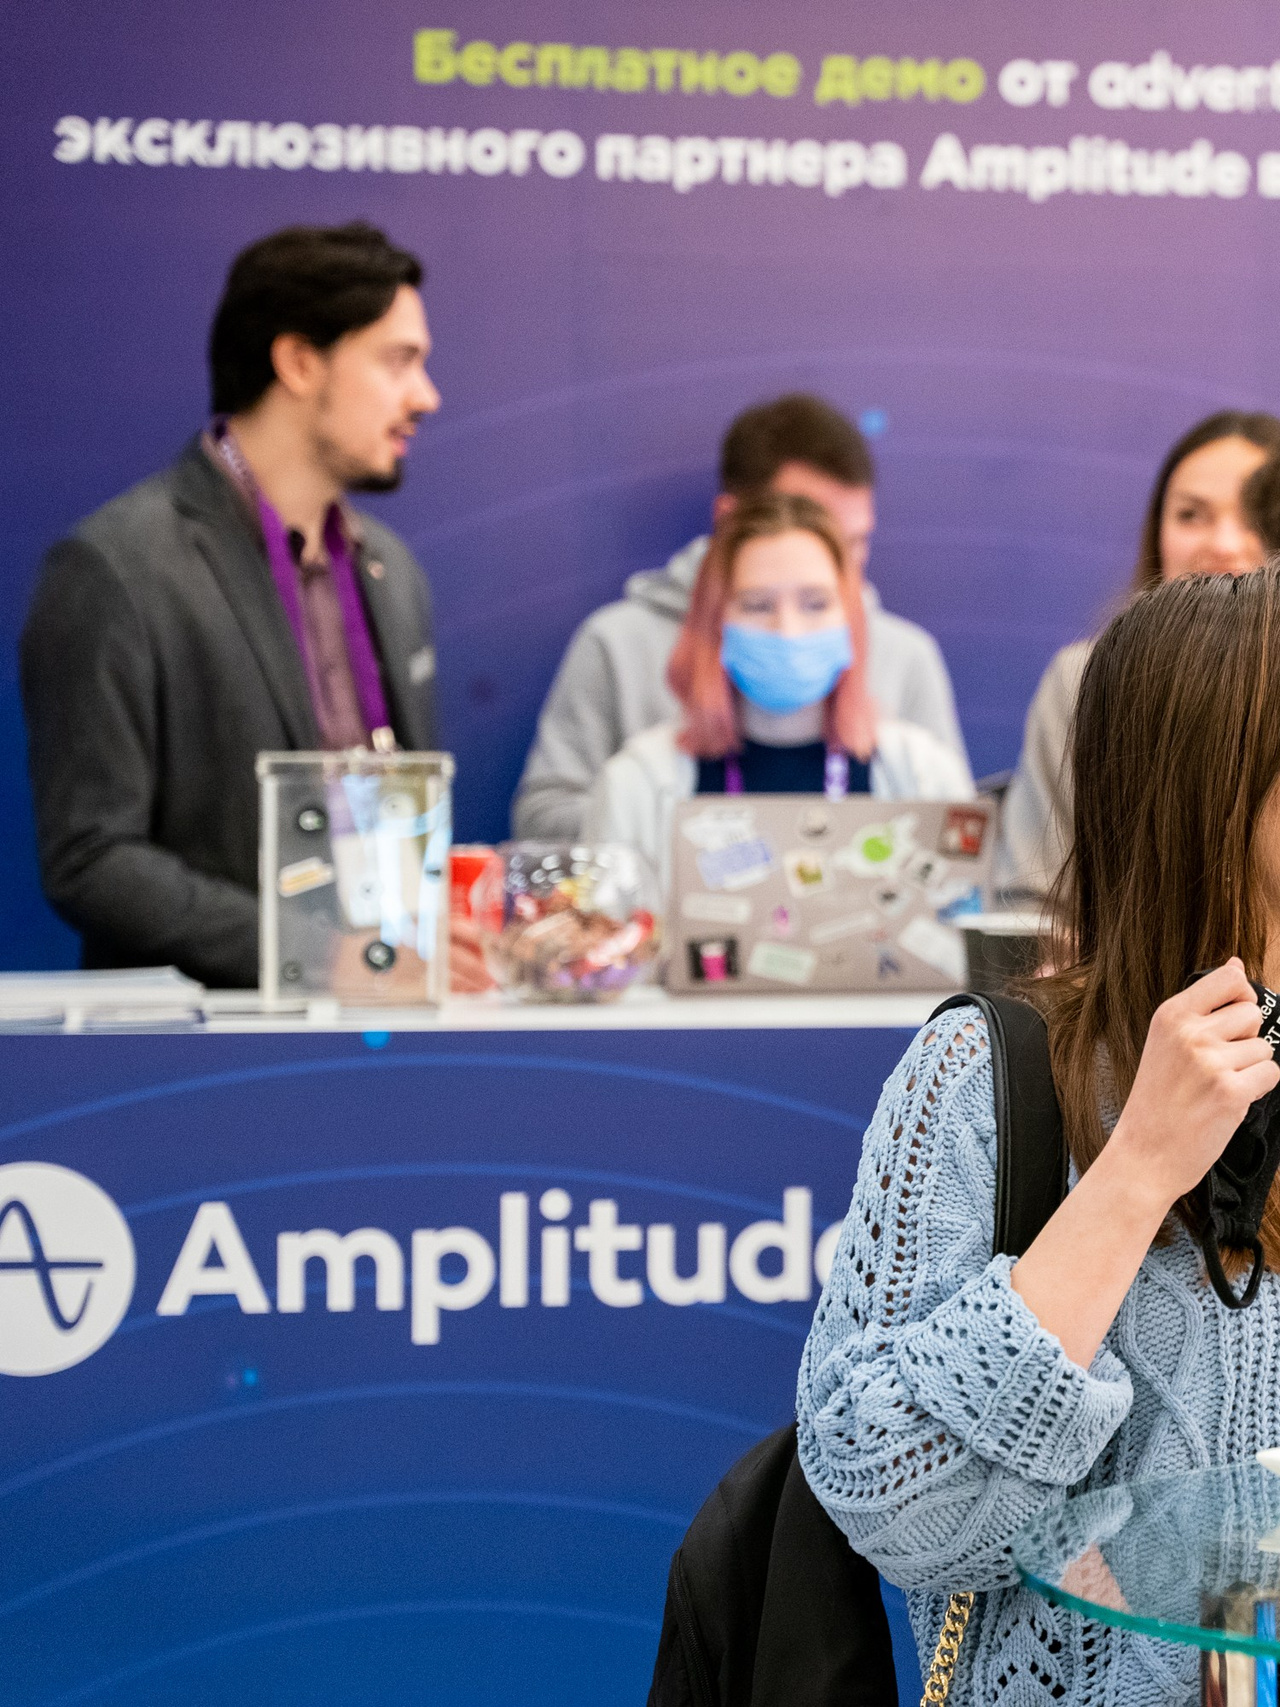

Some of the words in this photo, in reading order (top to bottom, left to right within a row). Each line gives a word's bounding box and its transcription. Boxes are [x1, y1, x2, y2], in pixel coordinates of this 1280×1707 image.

[413, 28, 801, 98] Бесплатное
[814, 53, 986, 107] демо
[998, 58, 1079, 108] от
[53, 114, 586, 179] эксклюзивного
[596, 133, 908, 199] партнера
[919, 132, 1252, 203] Amplitude
